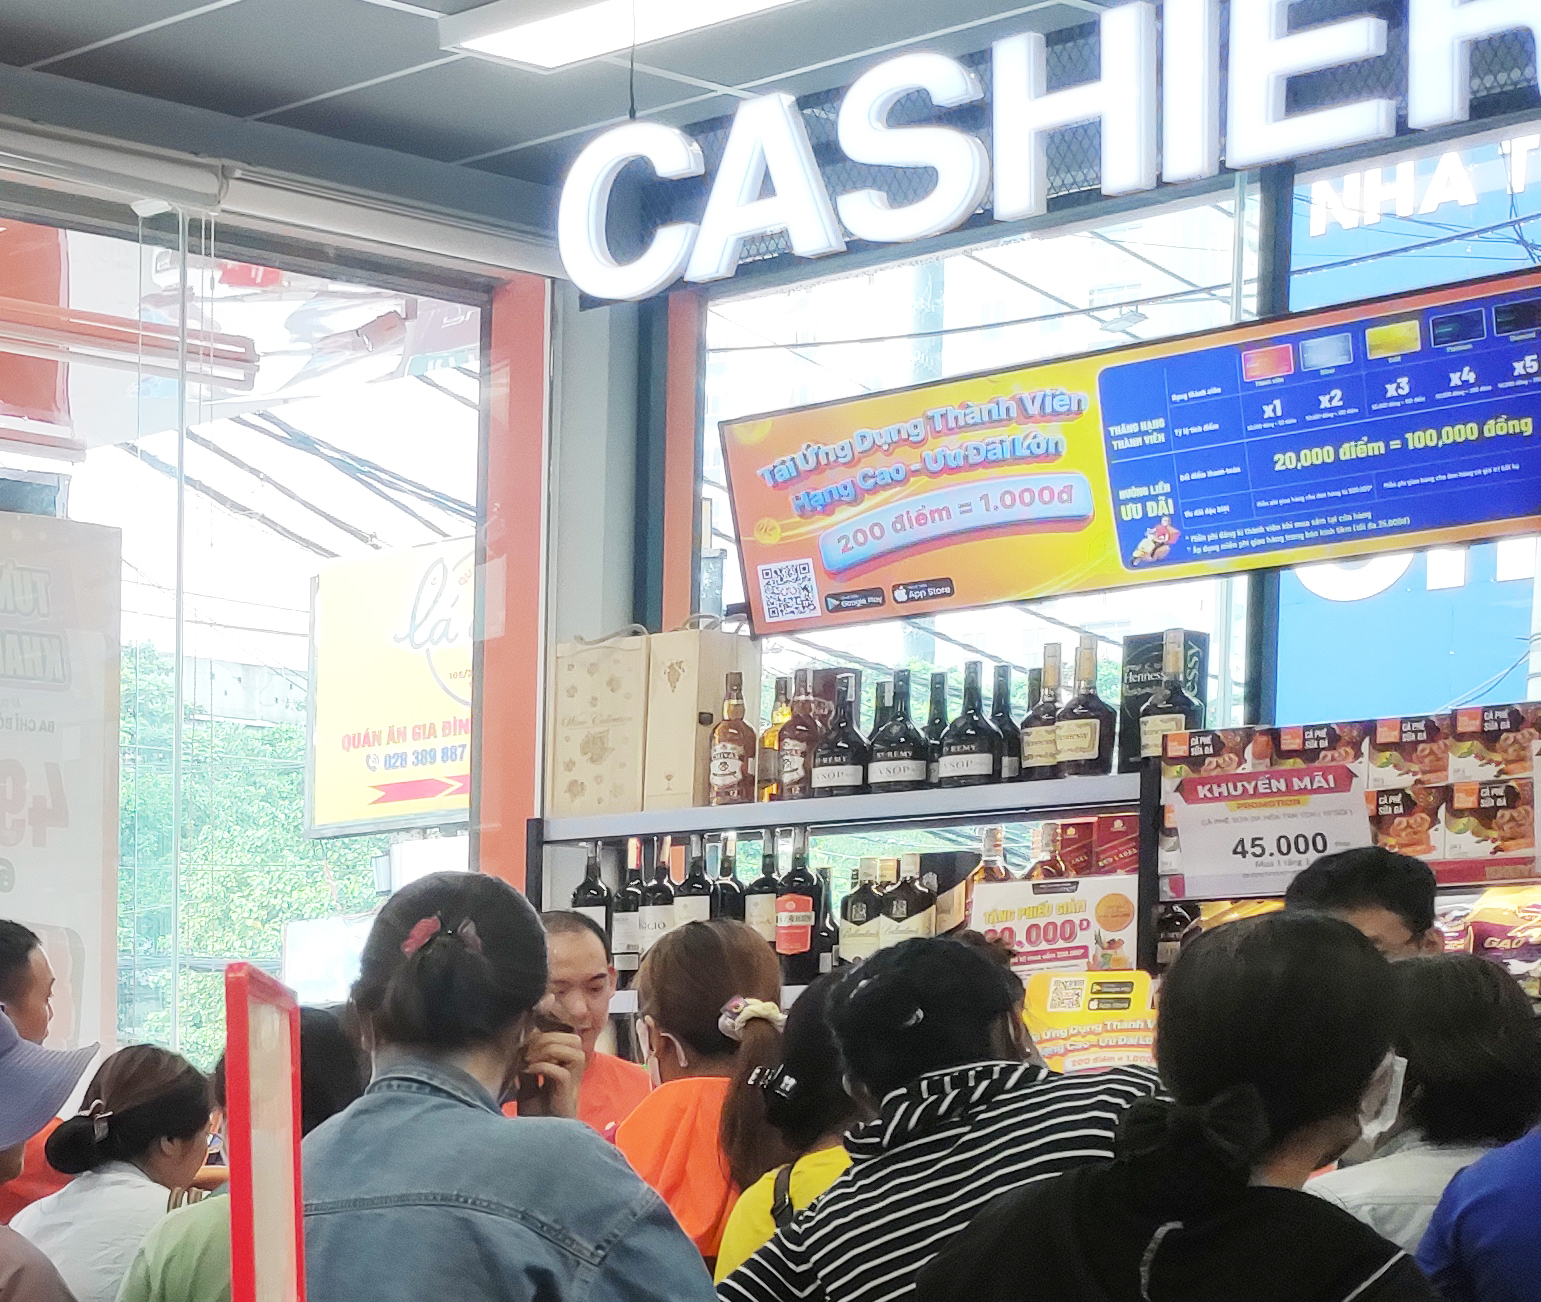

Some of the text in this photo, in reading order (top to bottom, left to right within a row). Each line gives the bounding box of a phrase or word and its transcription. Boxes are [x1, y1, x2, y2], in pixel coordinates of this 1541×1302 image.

[1273, 444, 1336, 472] 20,000
[1405, 421, 1479, 451] 100,000
[836, 523, 886, 555] 200
[441, 715, 472, 738] ĐÌN
[1197, 771, 1336, 799] KHUYẾN MÃI
[1231, 831, 1329, 859] 45.000
